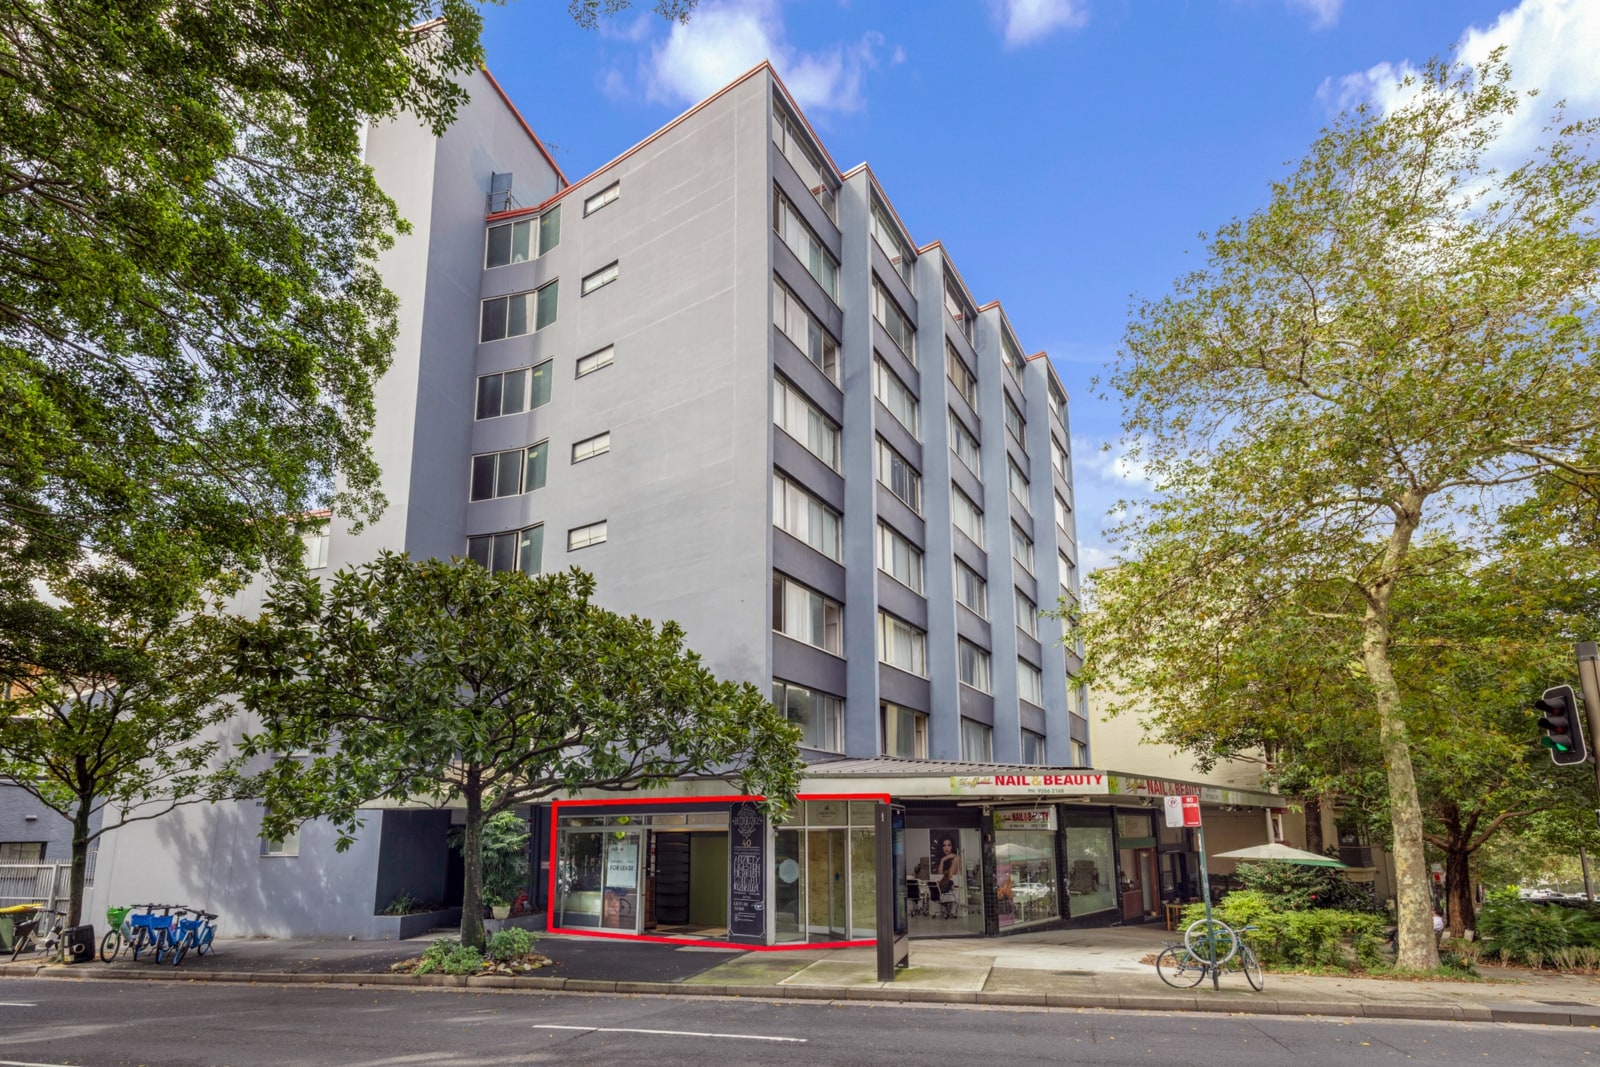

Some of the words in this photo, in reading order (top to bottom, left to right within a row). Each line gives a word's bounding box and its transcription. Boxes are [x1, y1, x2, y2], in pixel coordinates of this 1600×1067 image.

[995, 775, 1030, 786] NAIL
[1031, 775, 1041, 787] &
[1043, 774, 1103, 786] BEAUTY
[1146, 779, 1168, 796] NAIL
[1175, 783, 1202, 799] BEAUTY
